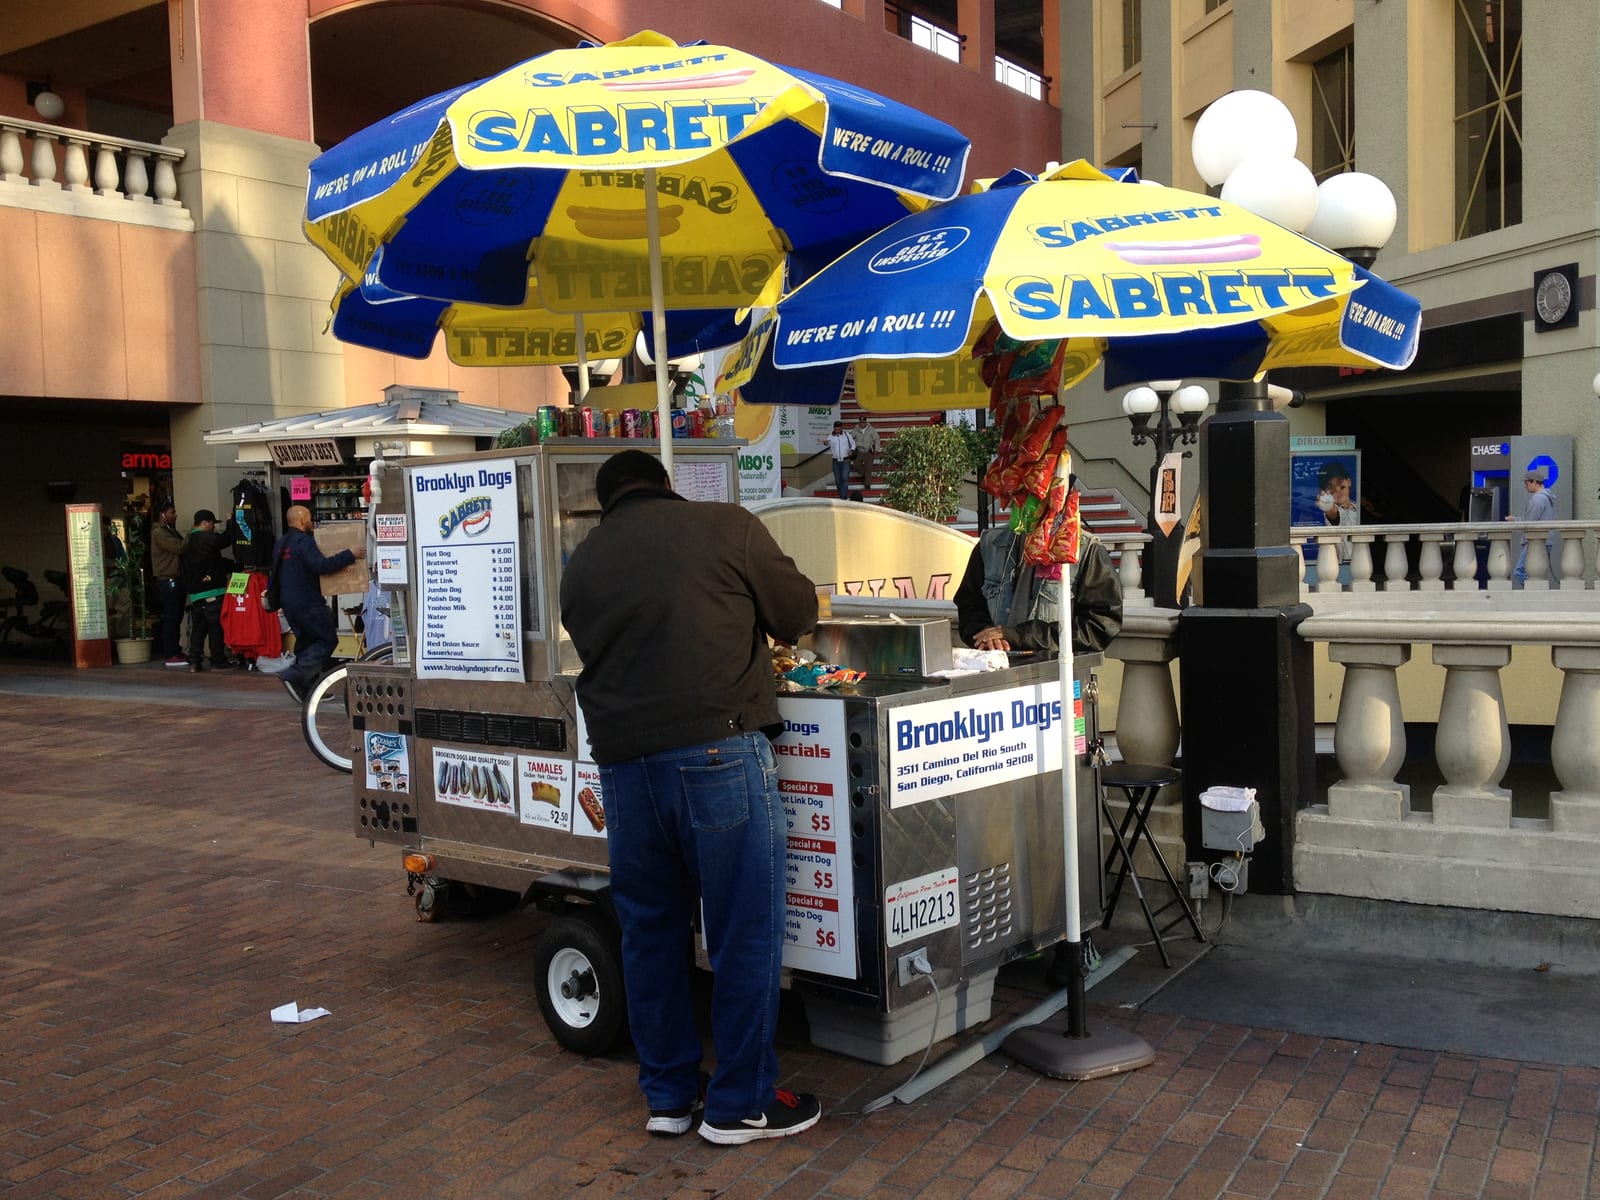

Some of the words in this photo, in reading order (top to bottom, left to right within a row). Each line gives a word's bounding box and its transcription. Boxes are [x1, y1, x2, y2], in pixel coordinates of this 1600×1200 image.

[524, 53, 729, 88] SABRETT
[468, 97, 772, 156] SABRET
[833, 127, 873, 153] WE'RE
[871, 139, 895, 159] ON
[891, 145, 904, 161] A
[901, 147, 933, 169] ROLL
[932, 155, 951, 174] !!!
[315, 173, 349, 200] WE'RE
[352, 168, 365, 186] ON
[363, 165, 376, 177] A
[379, 149, 407, 176] ROLL
[1027, 206, 1222, 248] SABRETT
[873, 247, 950, 268] INSPECTED
[1005, 267, 1338, 320] SABRETT
[787, 324, 838, 346] WE'RE
[840, 319, 865, 337] ON
[865, 316, 879, 334] A
[882, 312, 926, 332] ROLL
[930, 309, 956, 329] !!!
[1364, 307, 1378, 329] ON
[1373, 313, 1382, 330] A
[1378, 315, 1396, 338] ROLL
[1393, 322, 1406, 341] !!!
[1296, 437, 1349, 446] DIRECTORY
[1471, 444, 1501, 456] CHASE
[273, 445, 292, 465] SAN
[287, 444, 319, 462] DIEGO'S
[314, 442, 339, 463] BEST
[416, 472, 475, 493] Brooklyn
[478, 470, 512, 490] Dogs
[439, 496, 493, 539] SABRETT
[445, 568, 458, 576] Dog
[784, 720, 820, 736] Dogs
[896, 708, 1005, 752] Brooklyn
[1011, 699, 1062, 732] Dogs
[435, 751, 456, 760] BROOKLYN
[456, 753, 468, 761] DOGS
[477, 756, 497, 764] QUALITY
[897, 764, 919, 777] 3511
[922, 755, 960, 771] Camino
[963, 751, 979, 763] Del
[982, 748, 998, 759] Rio
[1000, 741, 1027, 754] South
[528, 761, 563, 775] TAMALES
[577, 771, 591, 780] Baja
[897, 781, 918, 792] San
[921, 771, 953, 787] Diego,
[956, 762, 1004, 779] California
[1006, 753, 1034, 768] 92108
[782, 782, 808, 792] Special
[809, 784, 819, 793] #2
[780, 795, 789, 804] ot
[790, 795, 806, 805] Link
[808, 797, 823, 809] Dog
[550, 810, 569, 824] $2.50
[785, 807, 797, 816] ink
[786, 818, 794, 828] ip
[812, 812, 831, 832] $5
[811, 842, 822, 850] #4
[786, 851, 814, 863] atwurst
[815, 854, 832, 866] Dog
[814, 869, 833, 889] $5
[787, 894, 813, 906] Special
[814, 899, 824, 908] #6
[896, 889, 919, 901] California
[786, 908, 805, 918] mbo
[807, 911, 822, 923] Dog
[892, 891, 955, 935] 4LH2213
[786, 920, 801, 930] rink
[785, 932, 798, 942] hip
[816, 928, 836, 948] $6
